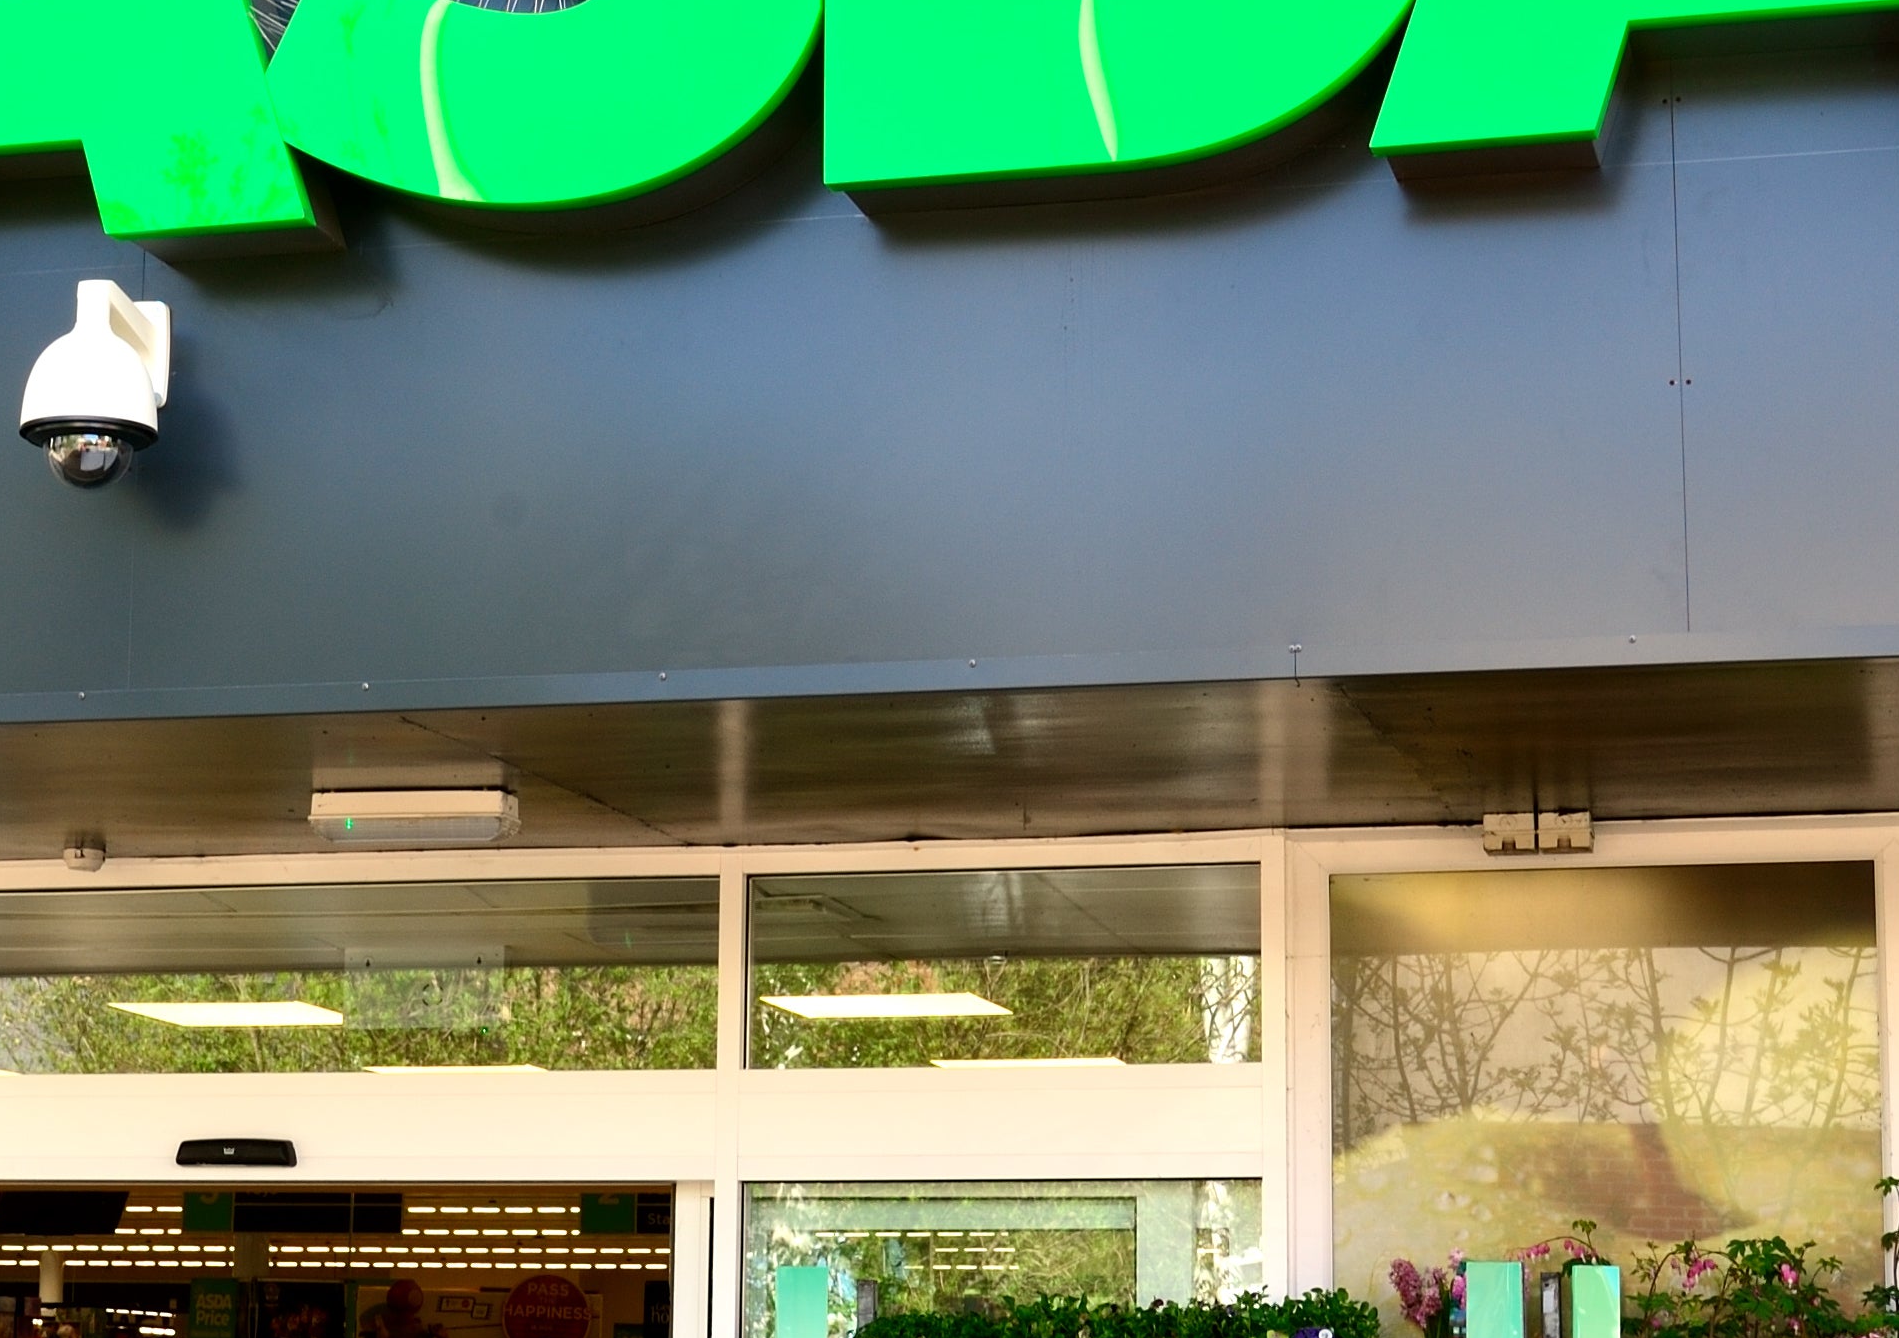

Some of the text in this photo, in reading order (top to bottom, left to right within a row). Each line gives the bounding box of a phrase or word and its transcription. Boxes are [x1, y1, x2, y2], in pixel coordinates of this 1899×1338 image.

[527, 1282, 569, 1297] PASS
[196, 1294, 231, 1310] ASDA
[196, 1310, 230, 1326] Price
[504, 1303, 592, 1321] HAPPINESS
